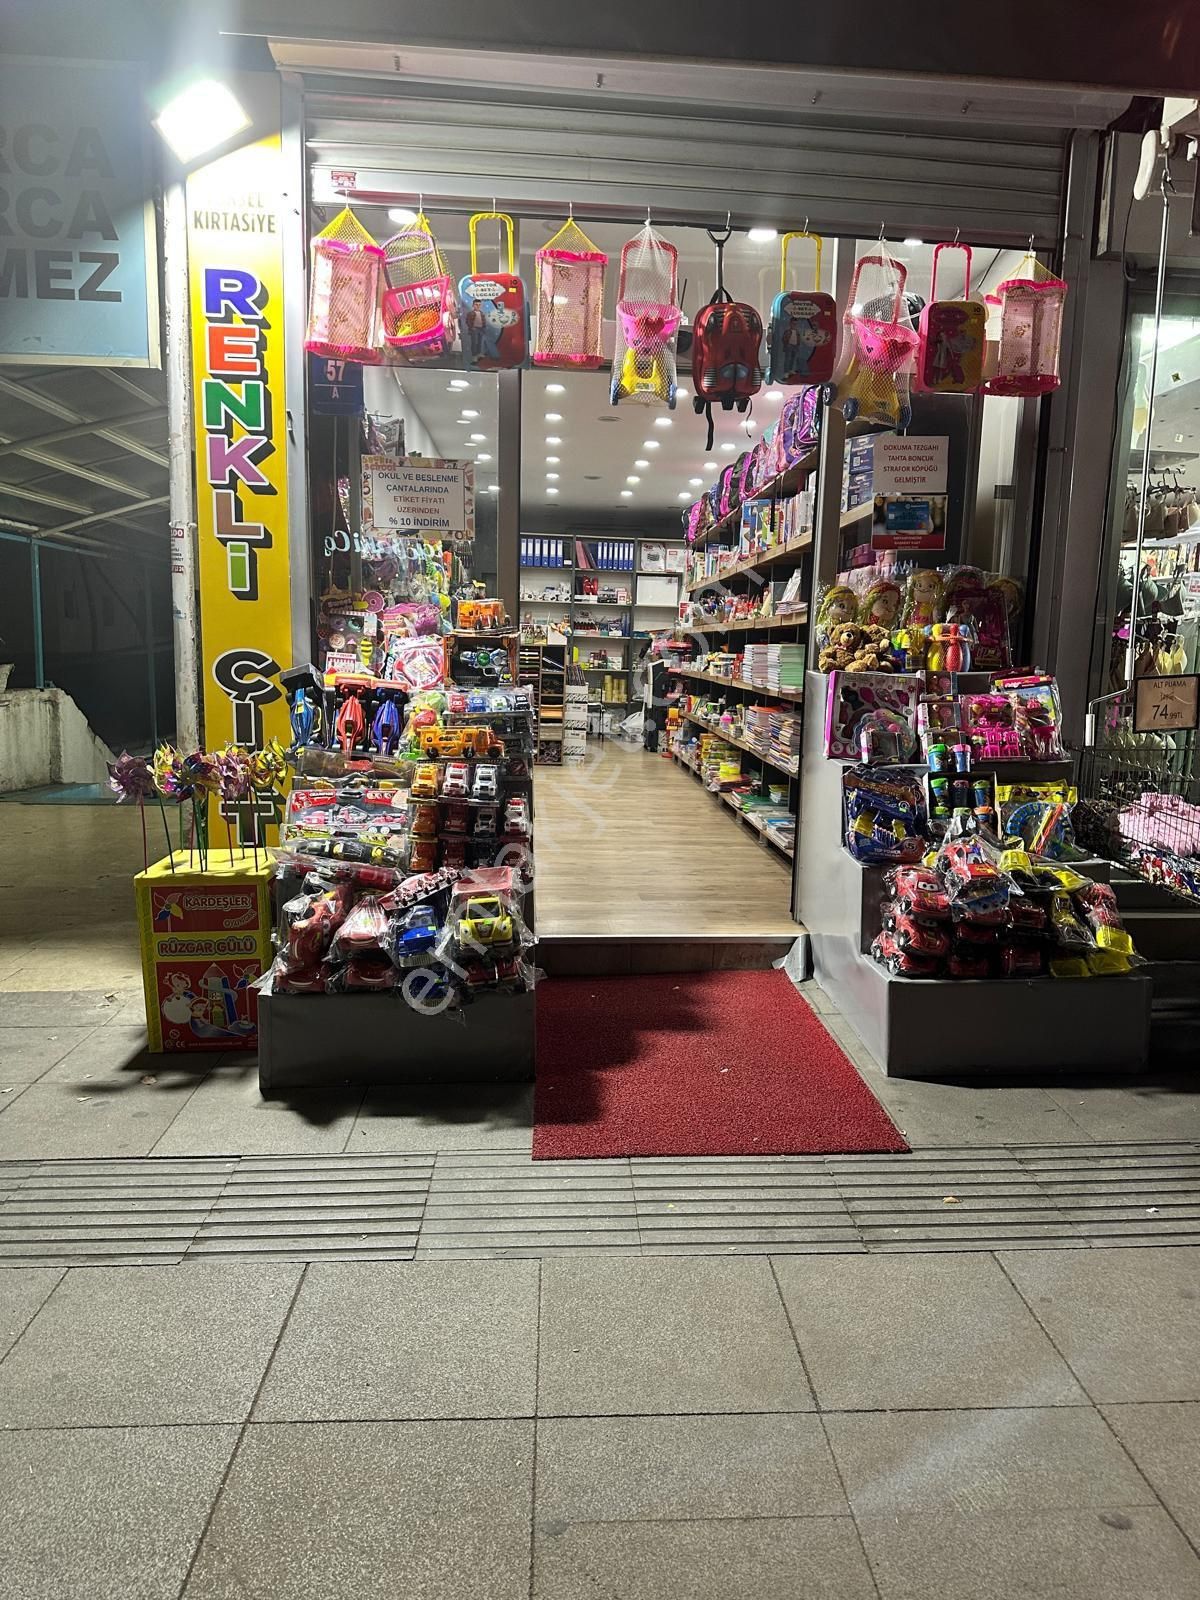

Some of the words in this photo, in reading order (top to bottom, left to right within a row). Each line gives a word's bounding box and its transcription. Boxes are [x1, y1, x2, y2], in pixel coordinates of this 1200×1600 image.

[0, 123, 116, 178] CA
[327, 360, 345, 381] 57
[332, 387, 339, 398] A
[402, 472, 414, 480] VE
[415, 473, 459, 483] BESLENME
[894, 476, 926, 484] GELMİŞTİR
[386, 484, 449, 494] ÇANTALARINDA
[393, 495, 420, 503] ETİKET
[421, 496, 445, 504] FİYATI
[396, 505, 440, 514] ÜZERİNDEN
[389, 517, 398, 525] %
[400, 517, 411, 525] 10
[413, 517, 450, 527] İNDİRİM
[184, 896, 250, 910] KARDEŞLER
[159, 939, 213, 954] RÜZGAR
[216, 937, 255, 953] GÜLÜ
